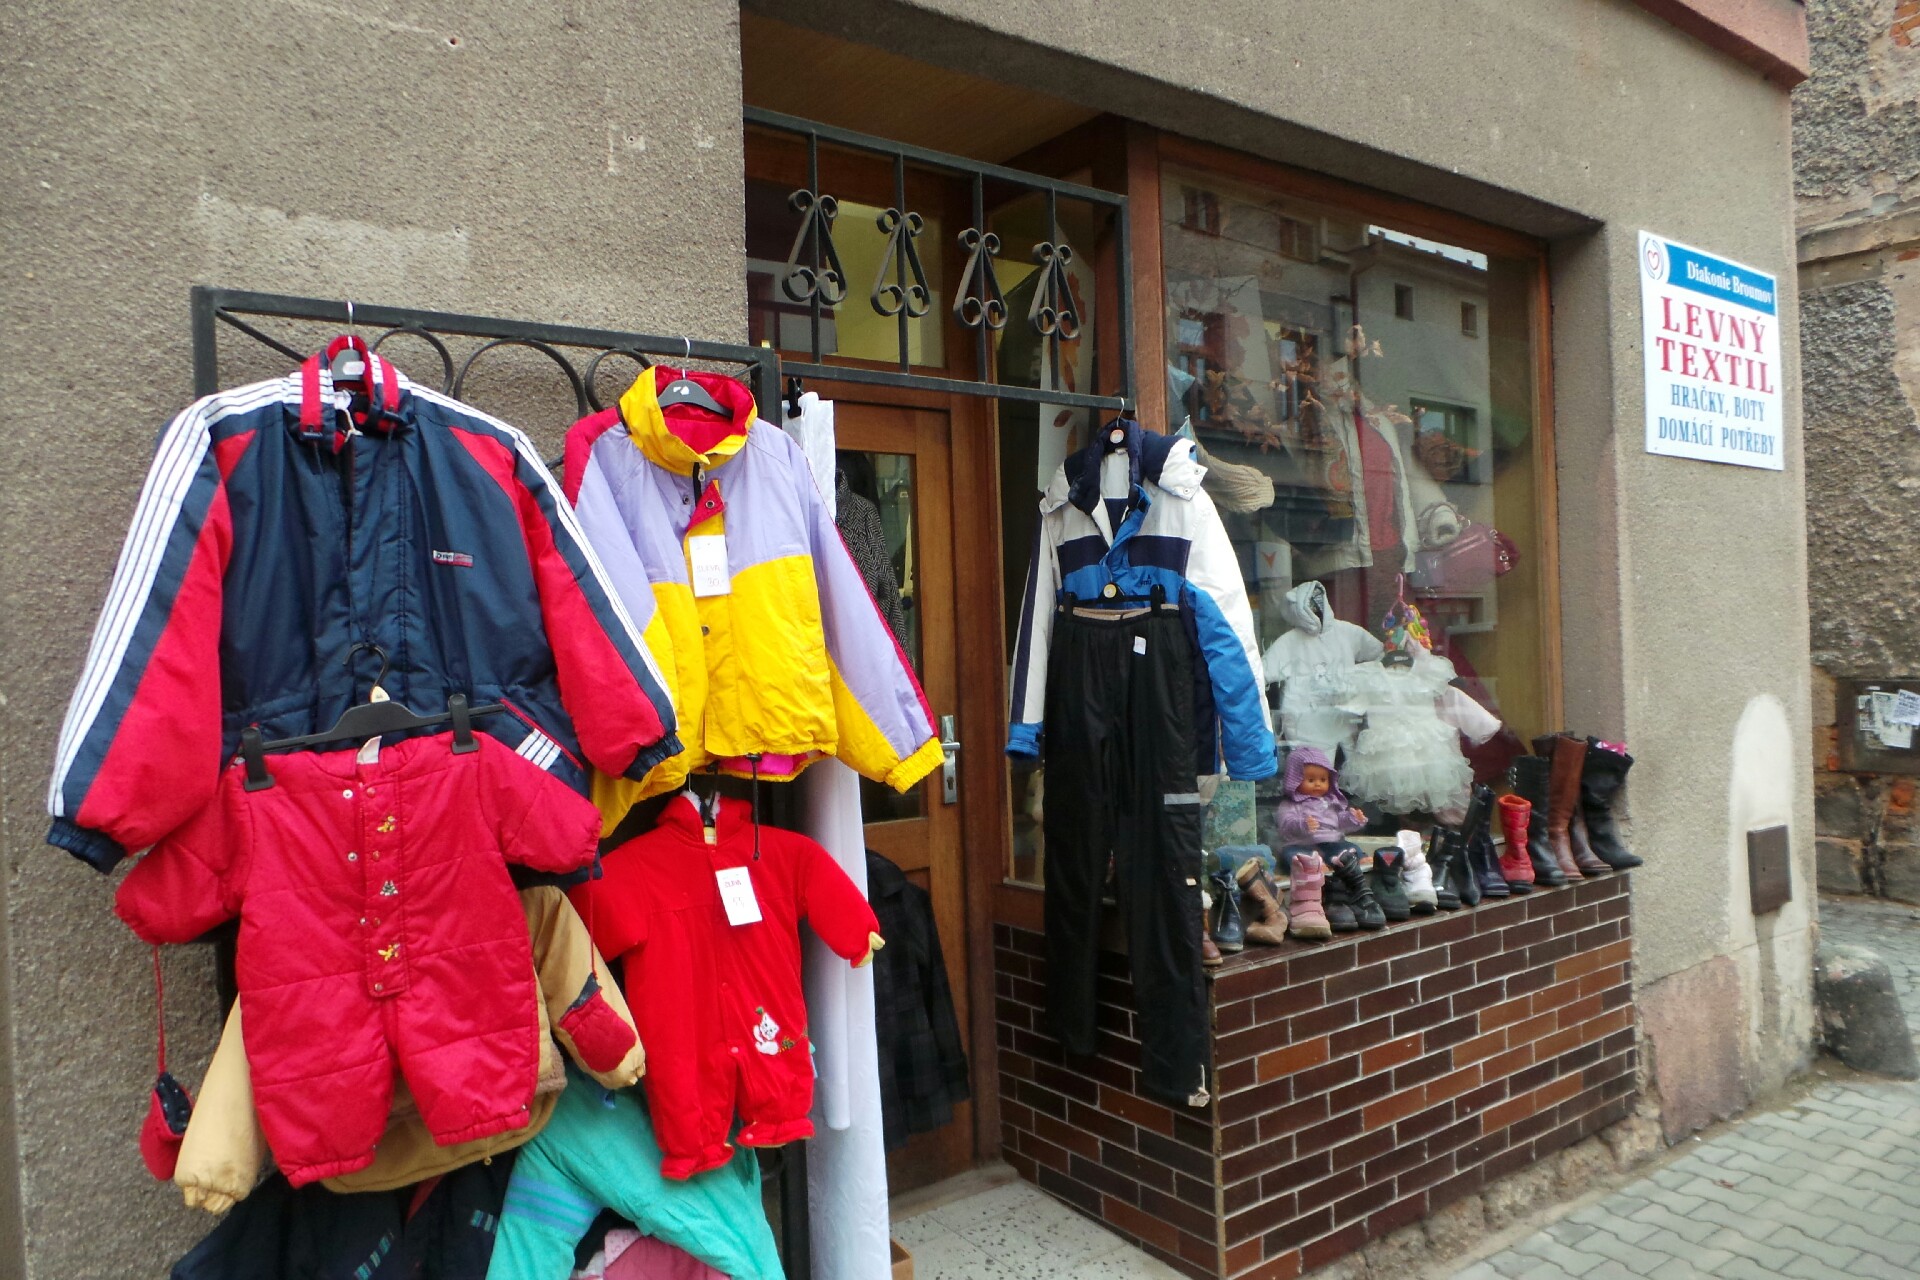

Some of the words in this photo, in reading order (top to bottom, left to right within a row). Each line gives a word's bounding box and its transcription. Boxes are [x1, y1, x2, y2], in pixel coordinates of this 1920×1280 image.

[1686, 260, 1731, 291] Diakonie
[1732, 275, 1773, 304] Broumov
[1661, 295, 1766, 354] LEVNÝ
[1656, 336, 1774, 394] TEXTIL
[1670, 383, 1729, 418] HRAČKY,
[1734, 396, 1765, 422] BOTY
[1658, 416, 1714, 446] DOMÁCÍ
[1721, 426, 1775, 456] POTŘEBY
